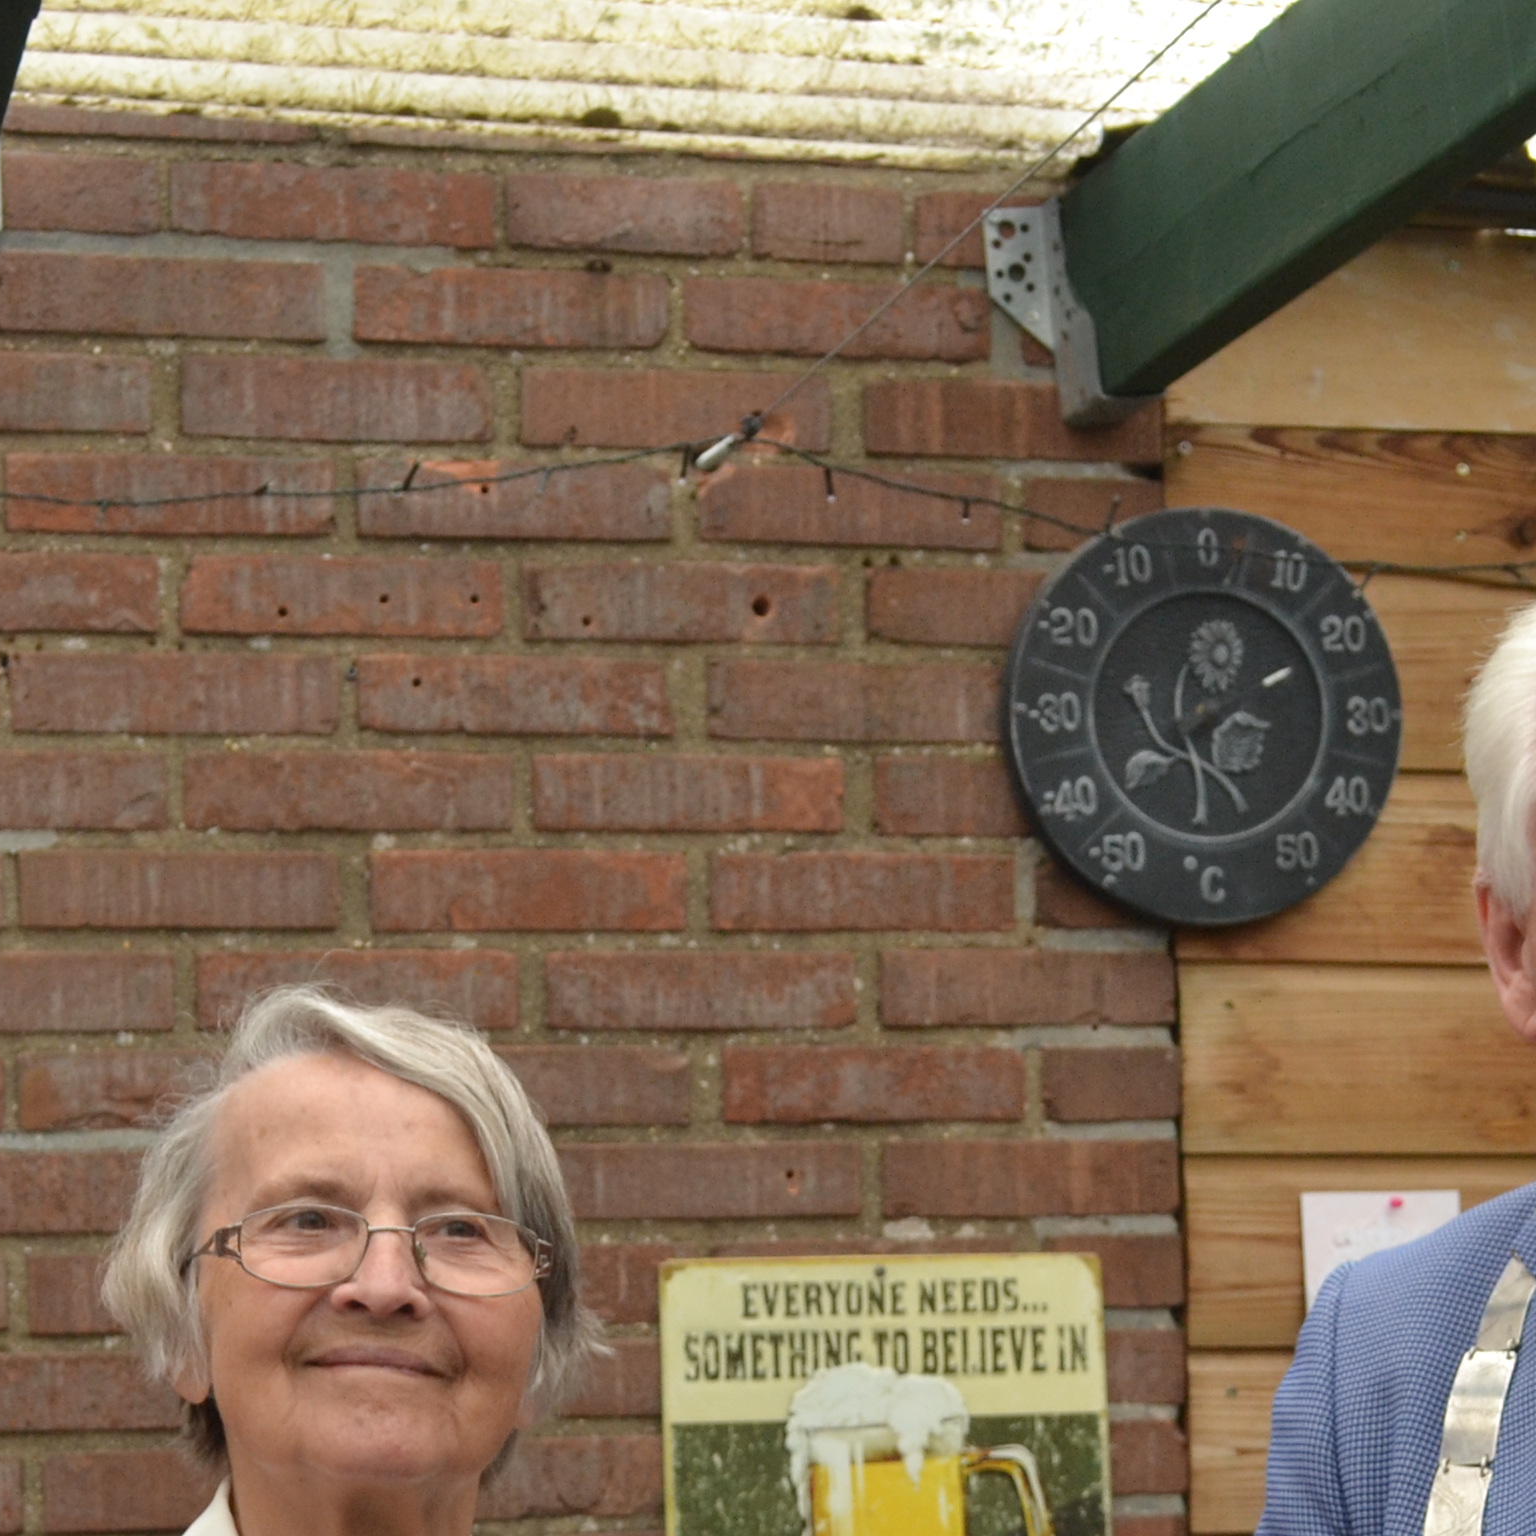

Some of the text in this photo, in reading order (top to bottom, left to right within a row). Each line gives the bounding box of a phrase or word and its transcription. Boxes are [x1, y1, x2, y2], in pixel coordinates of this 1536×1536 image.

[1102, 543, 1152, 586] -10
[1197, 528, 1219, 566] 0
[1270, 549, 1307, 592] 10
[1038, 606, 1098, 646] -20
[1320, 615, 1365, 652] 20
[1029, 691, 1081, 732] -30
[1346, 695, 1390, 735] 30
[1324, 775, 1371, 816] 40
[1088, 831, 1146, 871] -50
[1276, 831, 1319, 869] 50
[741, 1277, 1047, 1319] EVERYONE NEEDS...
[684, 1324, 1089, 1381] SOMETHING TO BELIEVE IN
